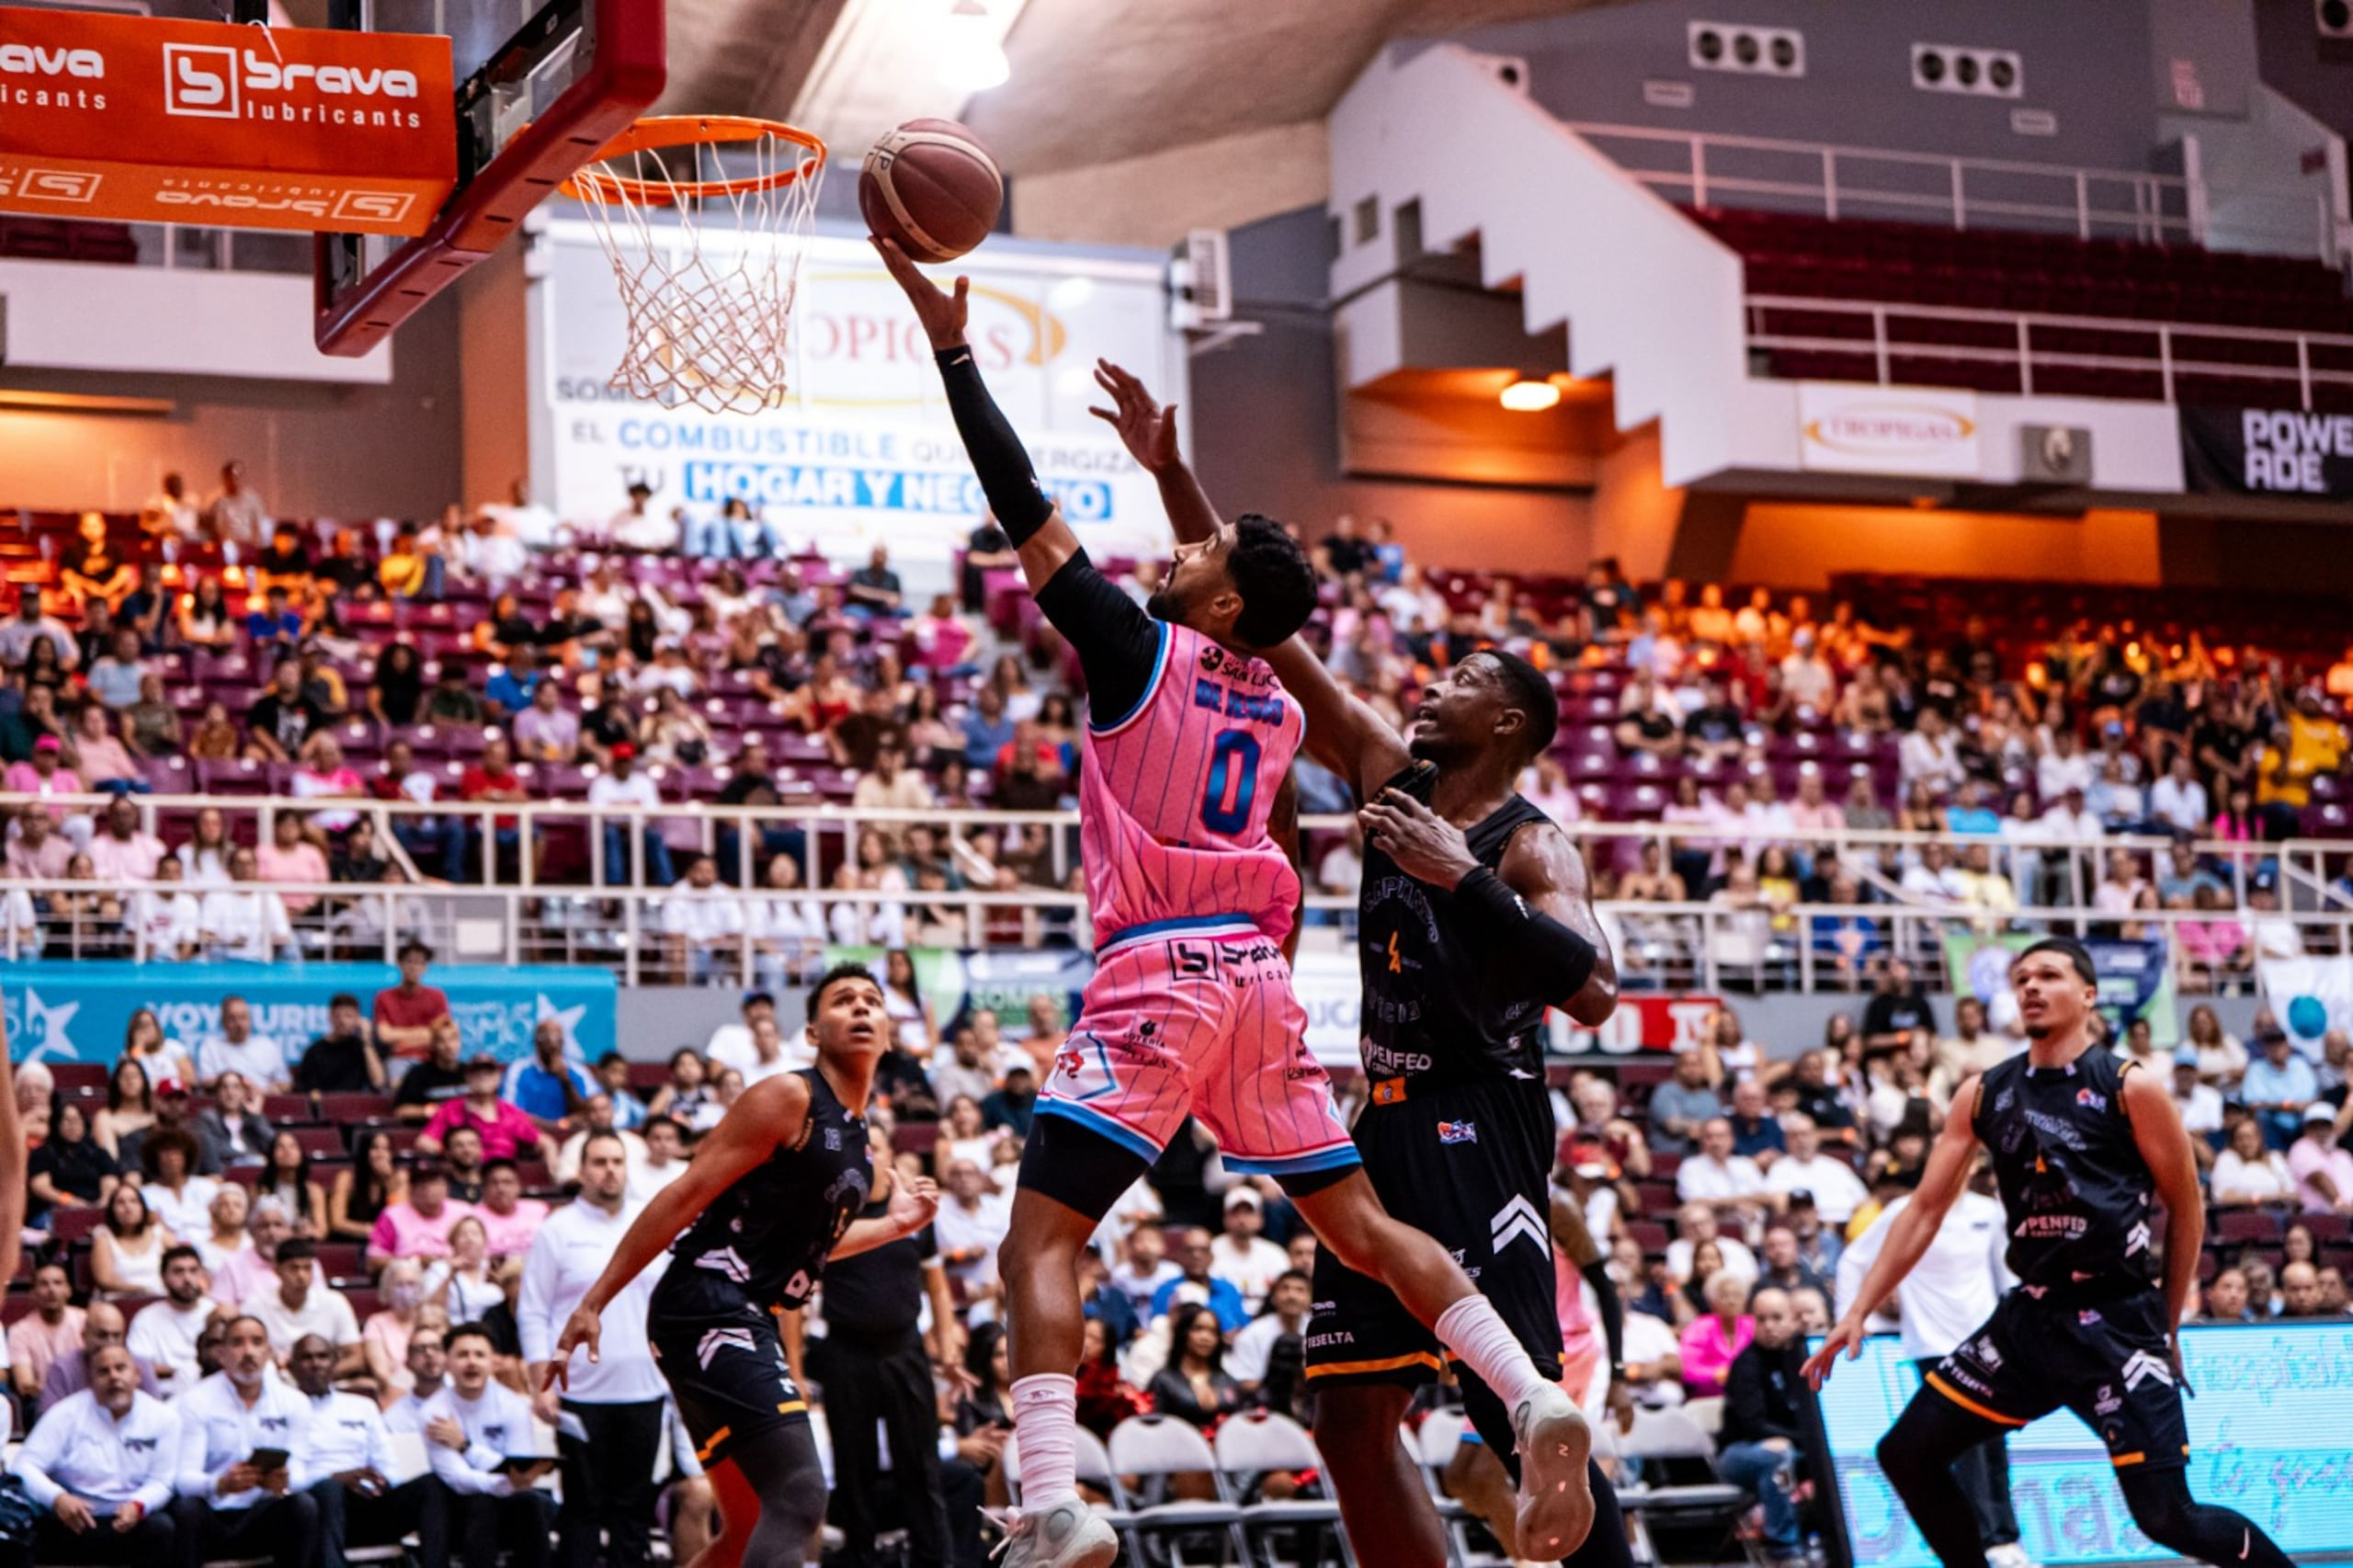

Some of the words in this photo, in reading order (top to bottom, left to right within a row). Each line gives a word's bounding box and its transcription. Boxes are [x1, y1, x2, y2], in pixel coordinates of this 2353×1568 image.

[244, 49, 419, 98] brava
[247, 100, 421, 129] lubricants
[571, 419, 605, 444] EL
[618, 419, 897, 460] COMBUSTIBLE
[691, 464, 854, 507] HOGAR
[858, 471, 893, 508] Y
[1195, 676, 1222, 714] DE
[1199, 728, 1262, 836] 0
